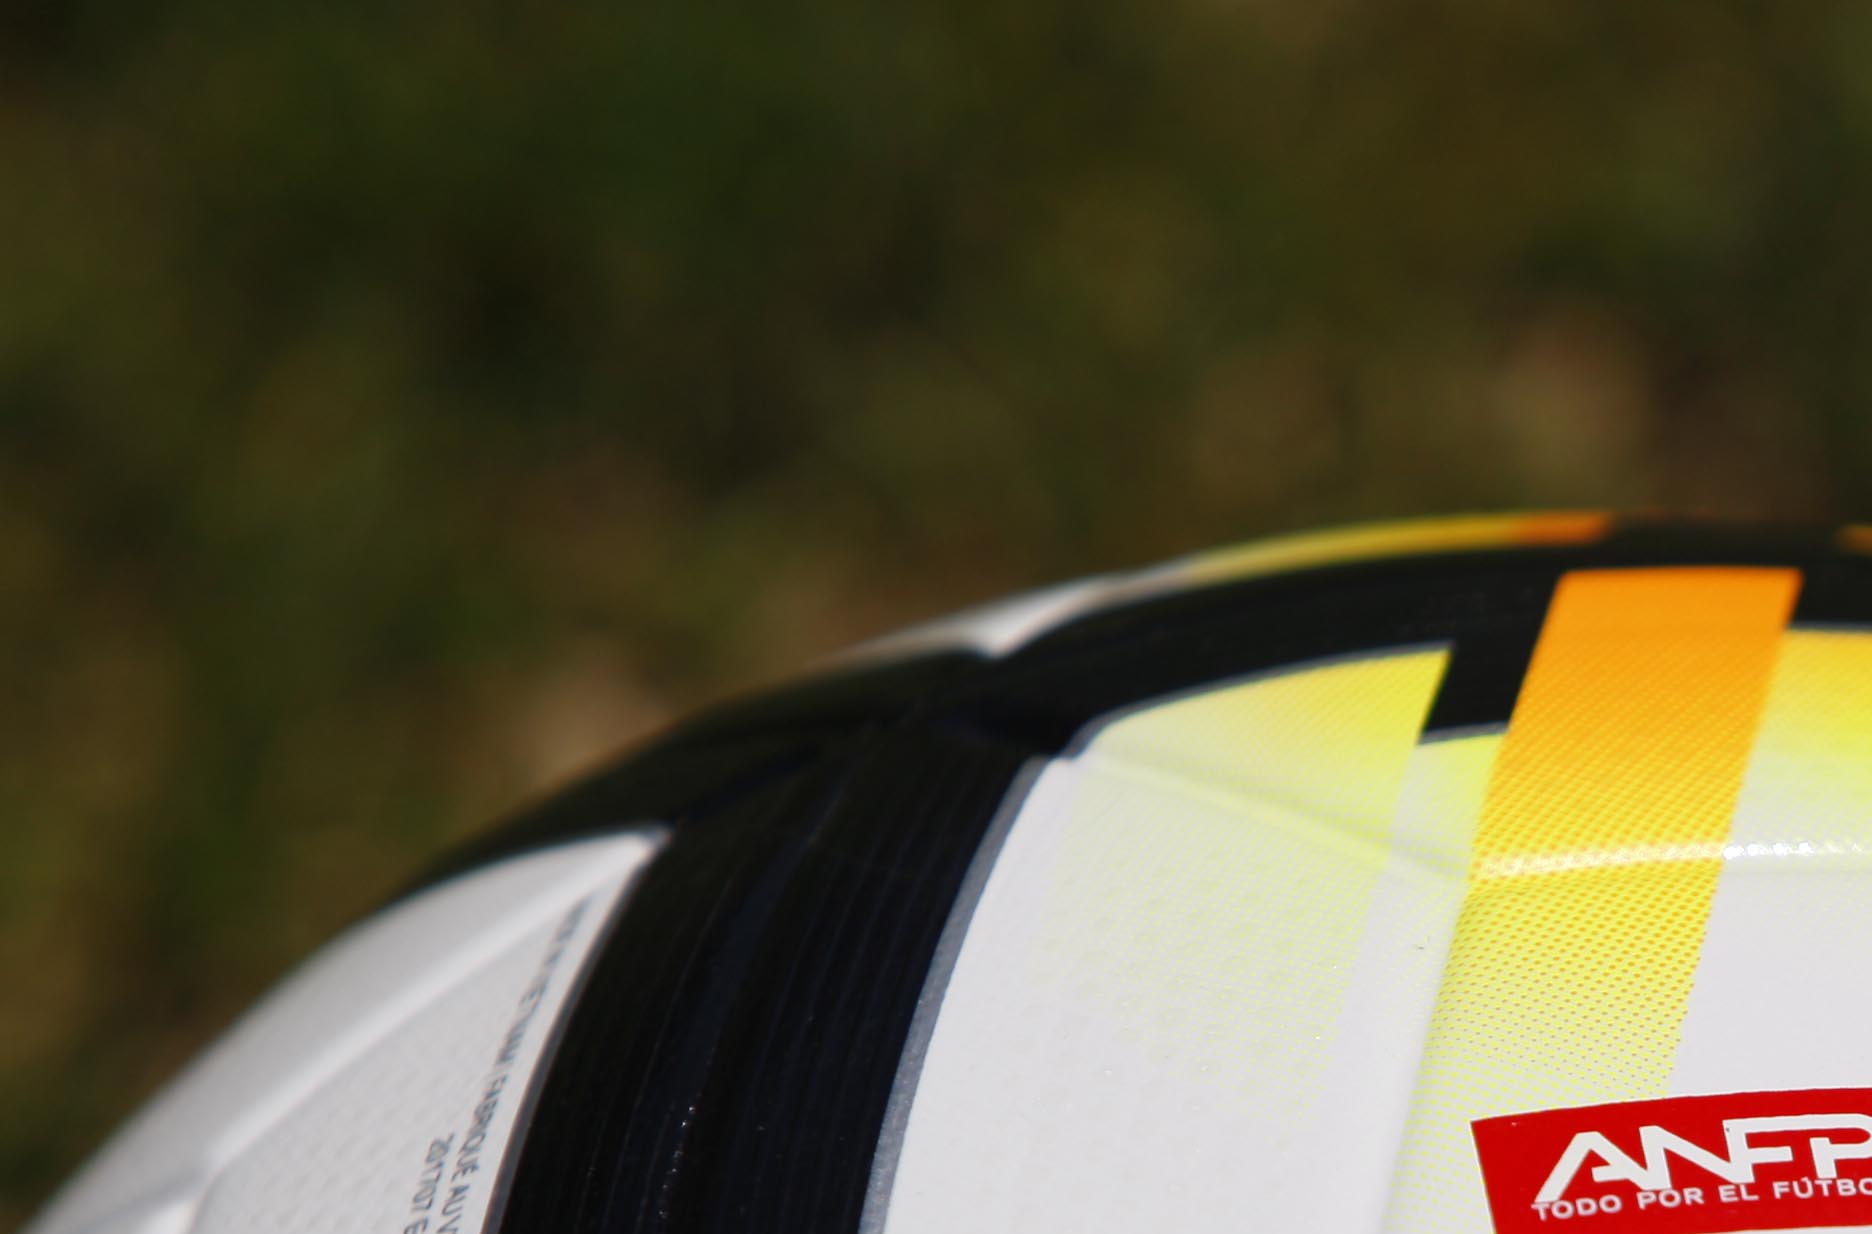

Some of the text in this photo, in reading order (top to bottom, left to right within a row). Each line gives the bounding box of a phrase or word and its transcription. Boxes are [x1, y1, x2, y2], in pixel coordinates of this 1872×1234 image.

[441, 1183, 471, 1217] AU
[1531, 1193, 1623, 1222] TODO
[1635, 1188, 1705, 1210] POR
[1718, 1183, 1759, 1203] EL
